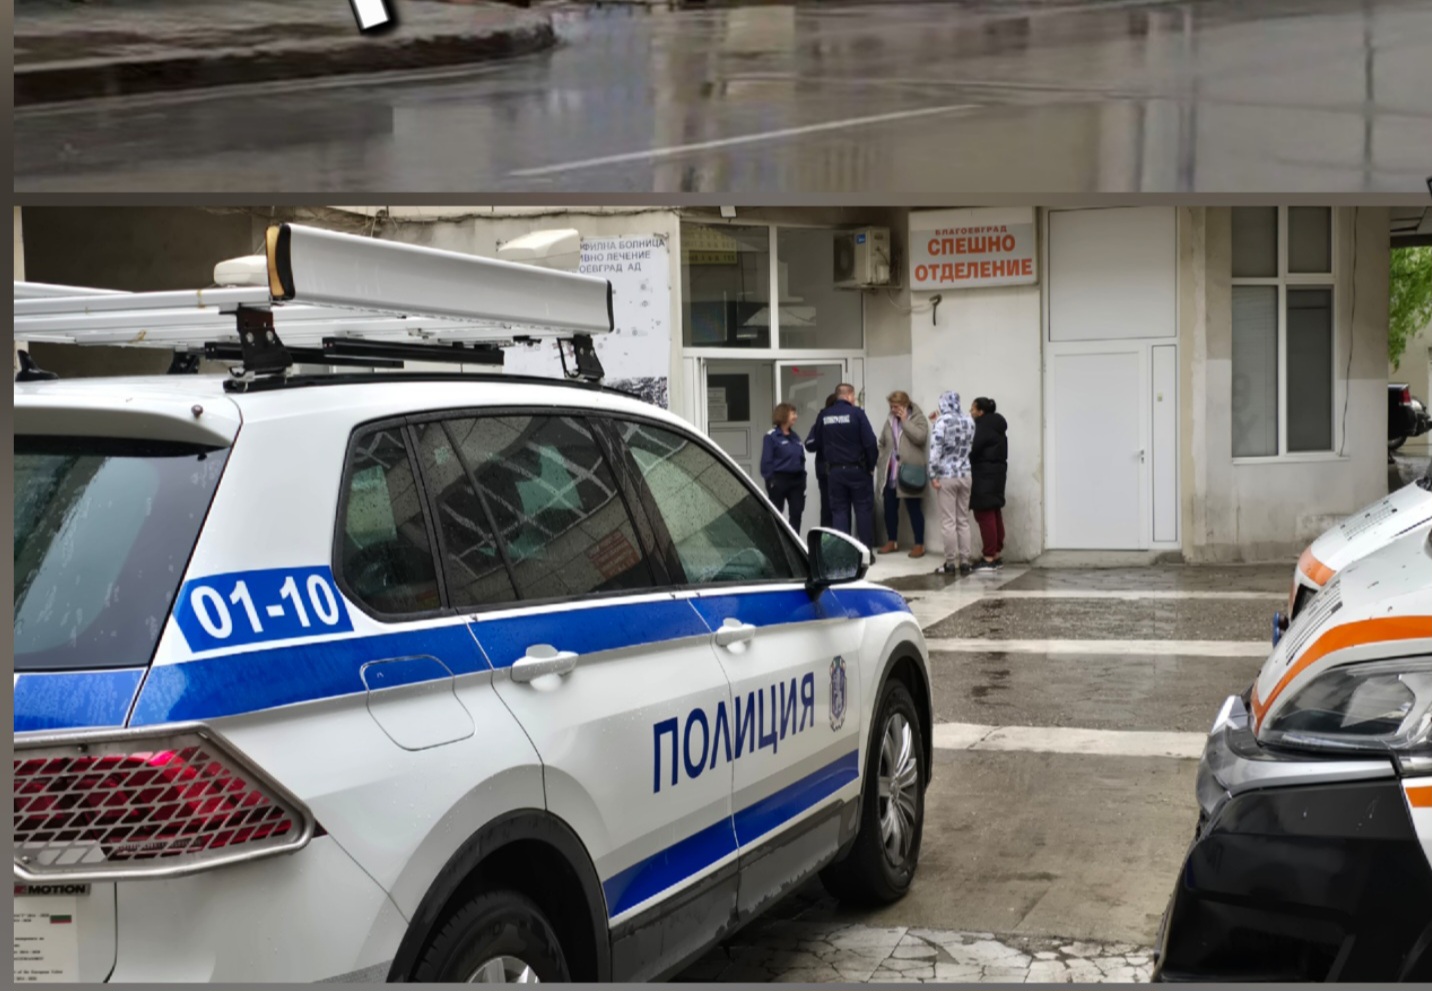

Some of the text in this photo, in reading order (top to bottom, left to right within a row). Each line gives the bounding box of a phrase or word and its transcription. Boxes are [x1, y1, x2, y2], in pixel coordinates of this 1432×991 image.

[935, 225, 1007, 237] БЛАГОЕВГРАД
[579, 240, 617, 251] ФИЛНА
[927, 234, 1016, 257] СПЕШНО
[606, 250, 651, 261] ЛЕЧЕНИЕ
[627, 262, 642, 273] АД
[914, 258, 1033, 283] ОТДЕЛЕНИЕ
[190, 574, 340, 640] 01-10
[653, 671, 814, 794] ПОЛИЦИЯ
